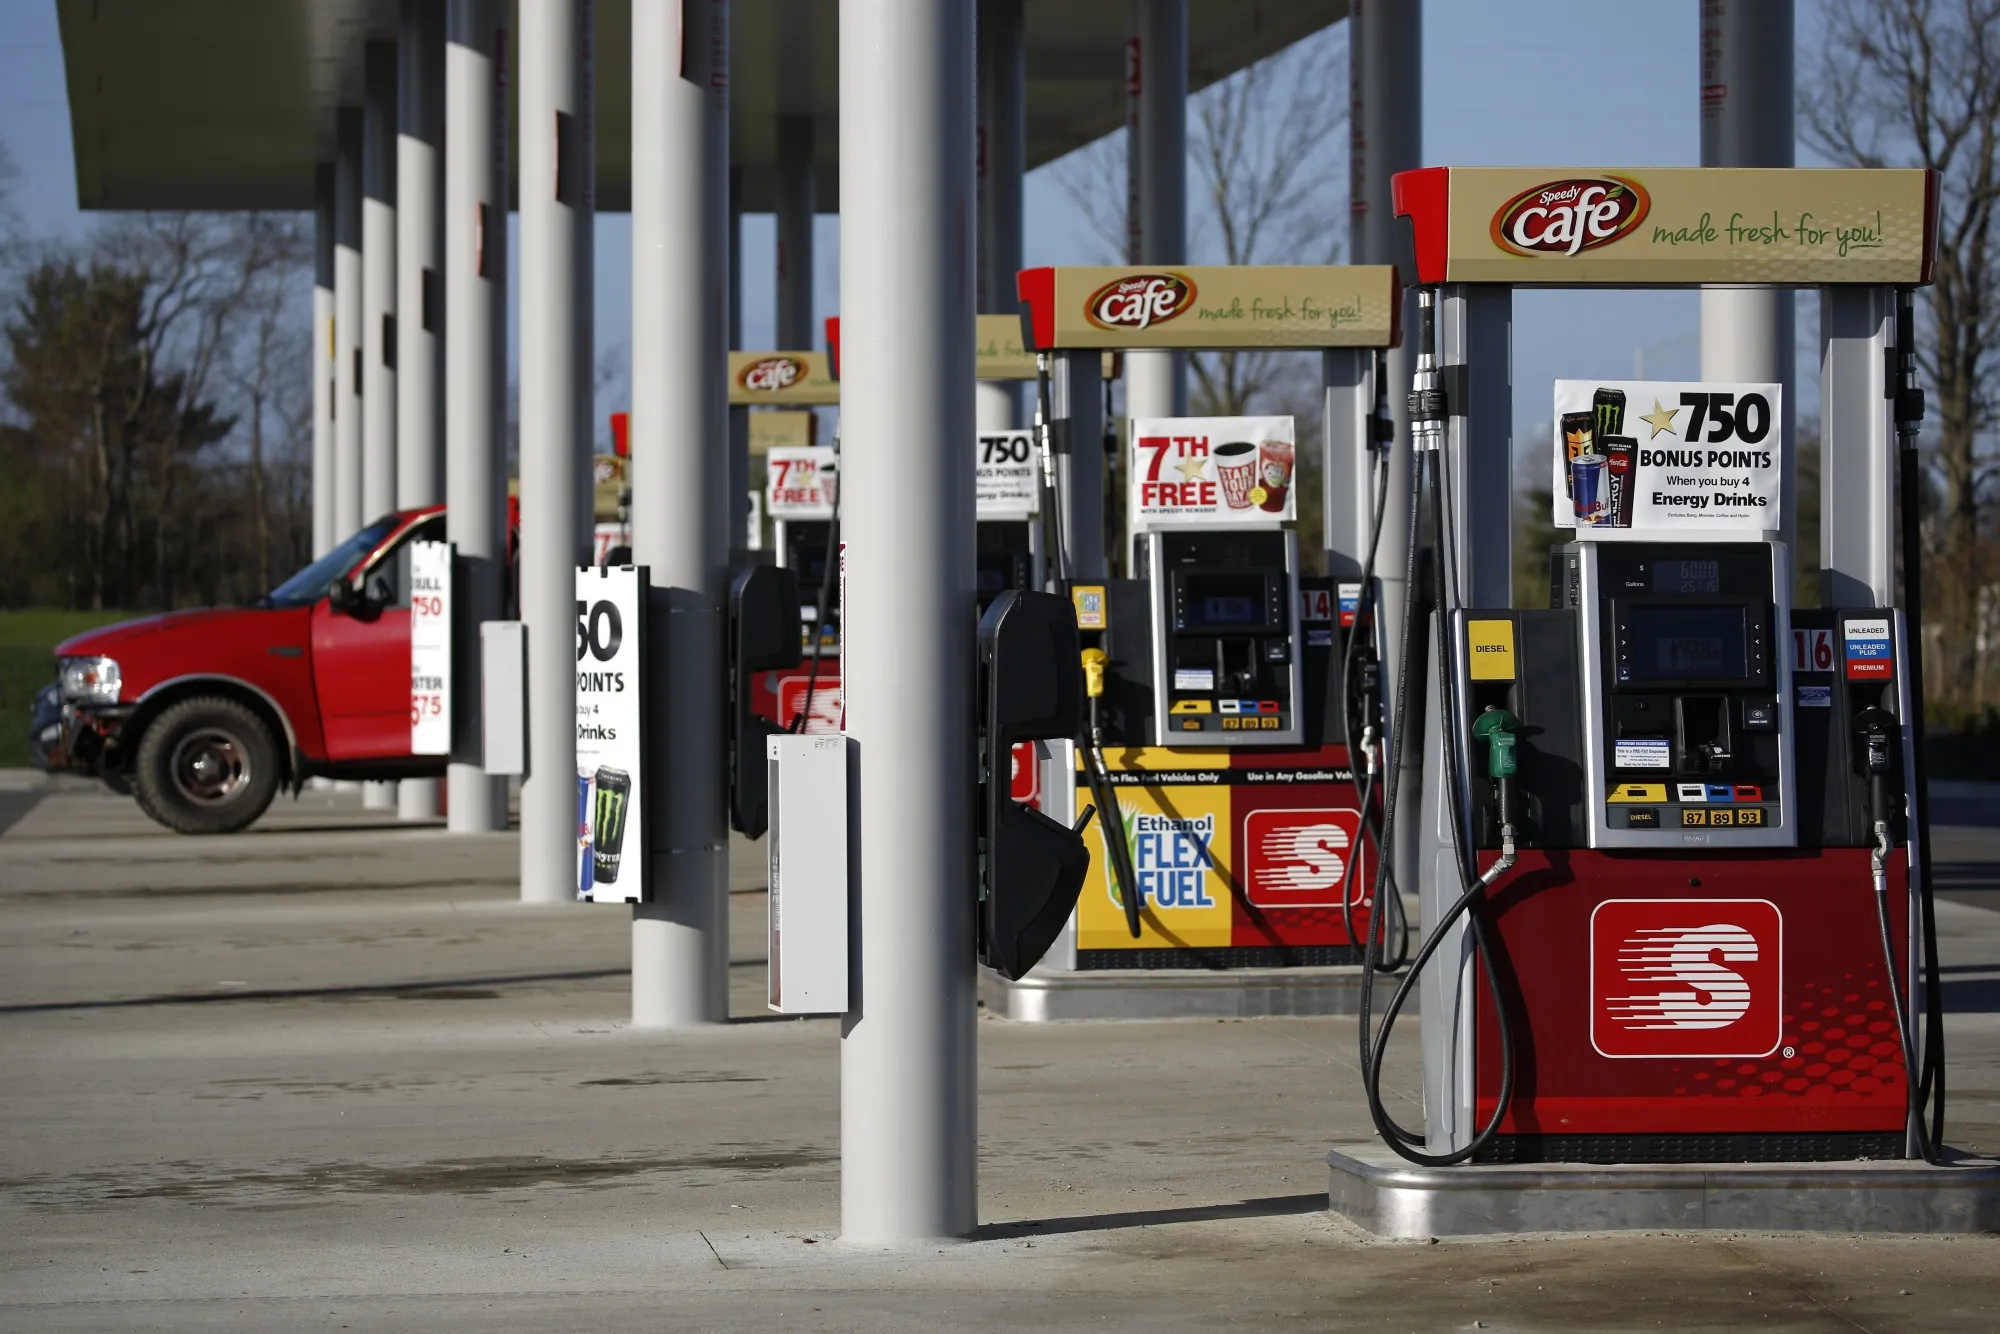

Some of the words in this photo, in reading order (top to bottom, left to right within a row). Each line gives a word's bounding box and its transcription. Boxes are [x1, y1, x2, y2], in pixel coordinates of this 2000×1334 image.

[1540, 186, 1581, 205] Speedy
[1652, 212, 1718, 245] made
[1725, 210, 1790, 245] fresh
[1794, 212, 1830, 245] for
[1836, 210, 1882, 257] you!
[1118, 279, 1148, 294] Speedy
[1199, 297, 1244, 321] made
[1249, 296, 1296, 321] fresh
[1300, 297, 1322, 320] for
[1329, 295, 1362, 328] you!
[1680, 392, 1770, 444] 750
[980, 436, 1029, 464] 750
[1640, 450, 1702, 468] BONUS
[1708, 450, 1772, 468] POINTS
[1667, 476, 1696, 486] When
[1698, 478, 1718, 488] you
[1720, 476, 1740, 488] buy
[1742, 477, 1750, 486] 4
[773, 488, 820, 503] FREE
[1142, 482, 1217, 506] FREE
[1652, 492, 1709, 508] Energy
[1714, 492, 1767, 506] Drinks
[1303, 592, 1328, 618] 14
[593, 704, 599, 714] 4
[578, 724, 616, 740] Drinks
[1110, 774, 1119, 782] in
[1120, 774, 1139, 782] Flex
[1160, 773, 1196, 782] Vehicles
[1198, 773, 1219, 783] Only
[1247, 773, 1264, 781] Use
[1265, 772, 1274, 780] in
[1276, 772, 1294, 782] Any
[1296, 771, 1333, 780] Gasoline
[1138, 816, 1212, 831] Ethanol
[1686, 812, 1702, 824] 87
[1713, 813, 1730, 825] 89
[1741, 812, 1757, 823] 93
[1138, 833, 1213, 868] FLEX
[1138, 870, 1213, 907] FUEL
